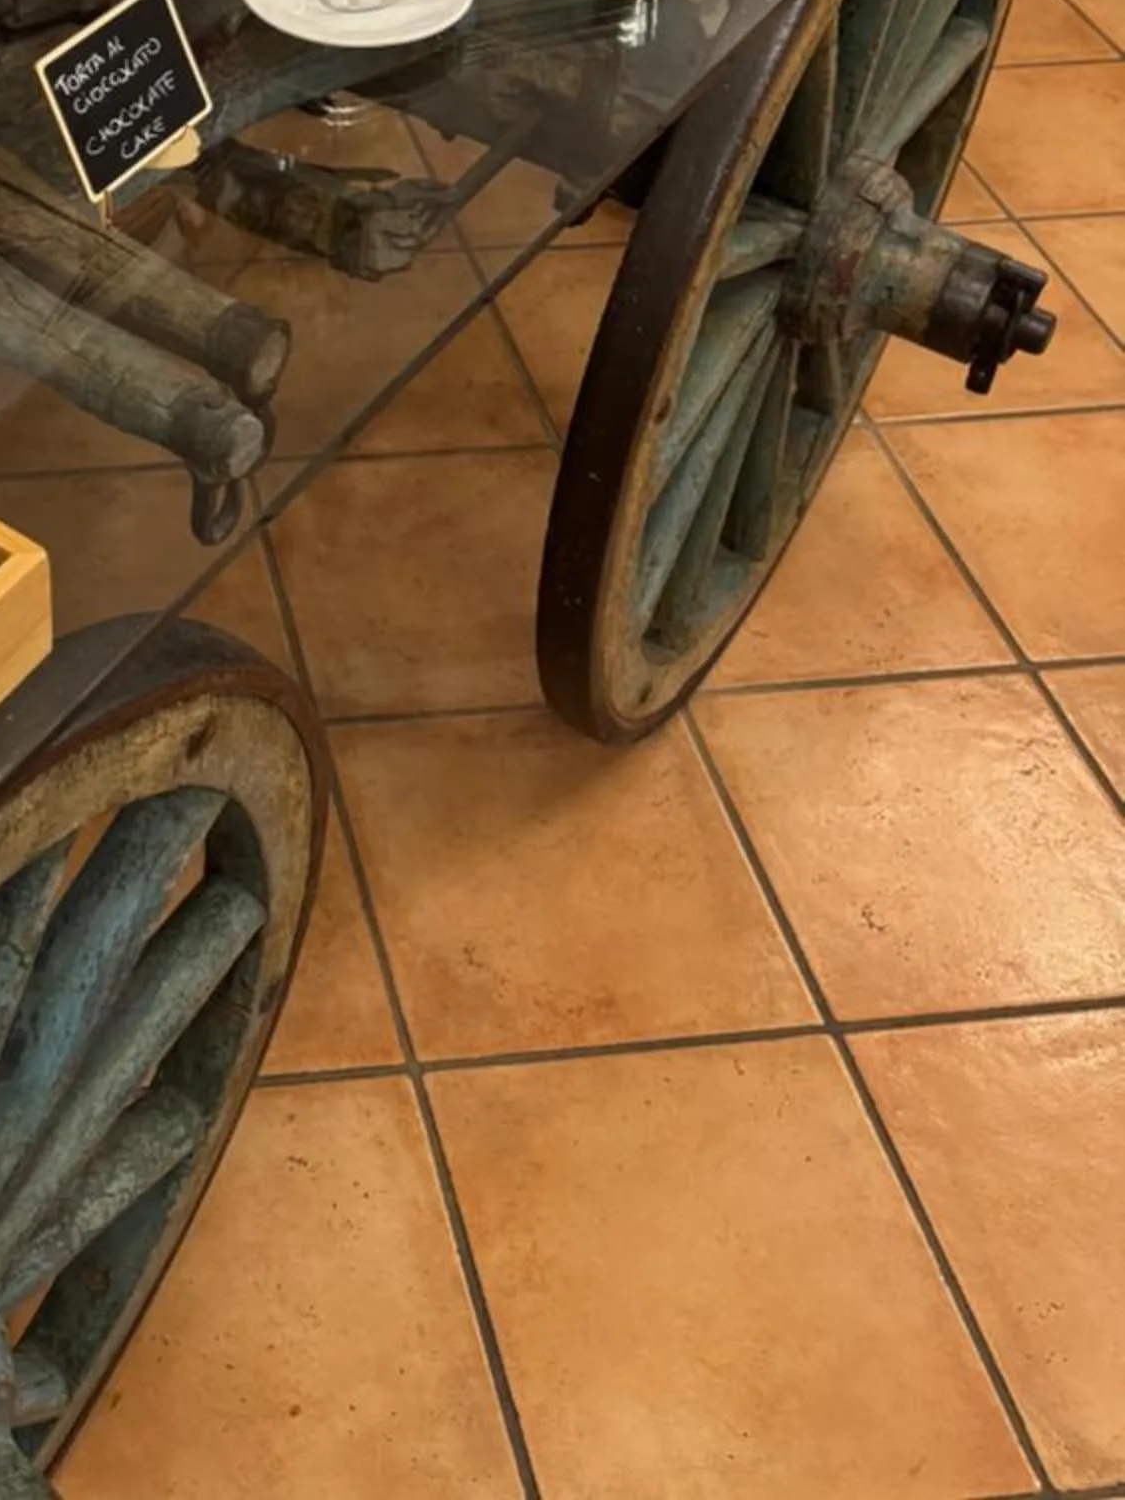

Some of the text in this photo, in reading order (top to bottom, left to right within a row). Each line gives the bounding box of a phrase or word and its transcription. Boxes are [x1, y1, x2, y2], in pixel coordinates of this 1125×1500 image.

[54, 35, 126, 97] TORTA AL
[73, 36, 162, 115] CIOCCOLATO
[85, 68, 178, 156] CHOCOLATE
[120, 116, 167, 160] CAKE
